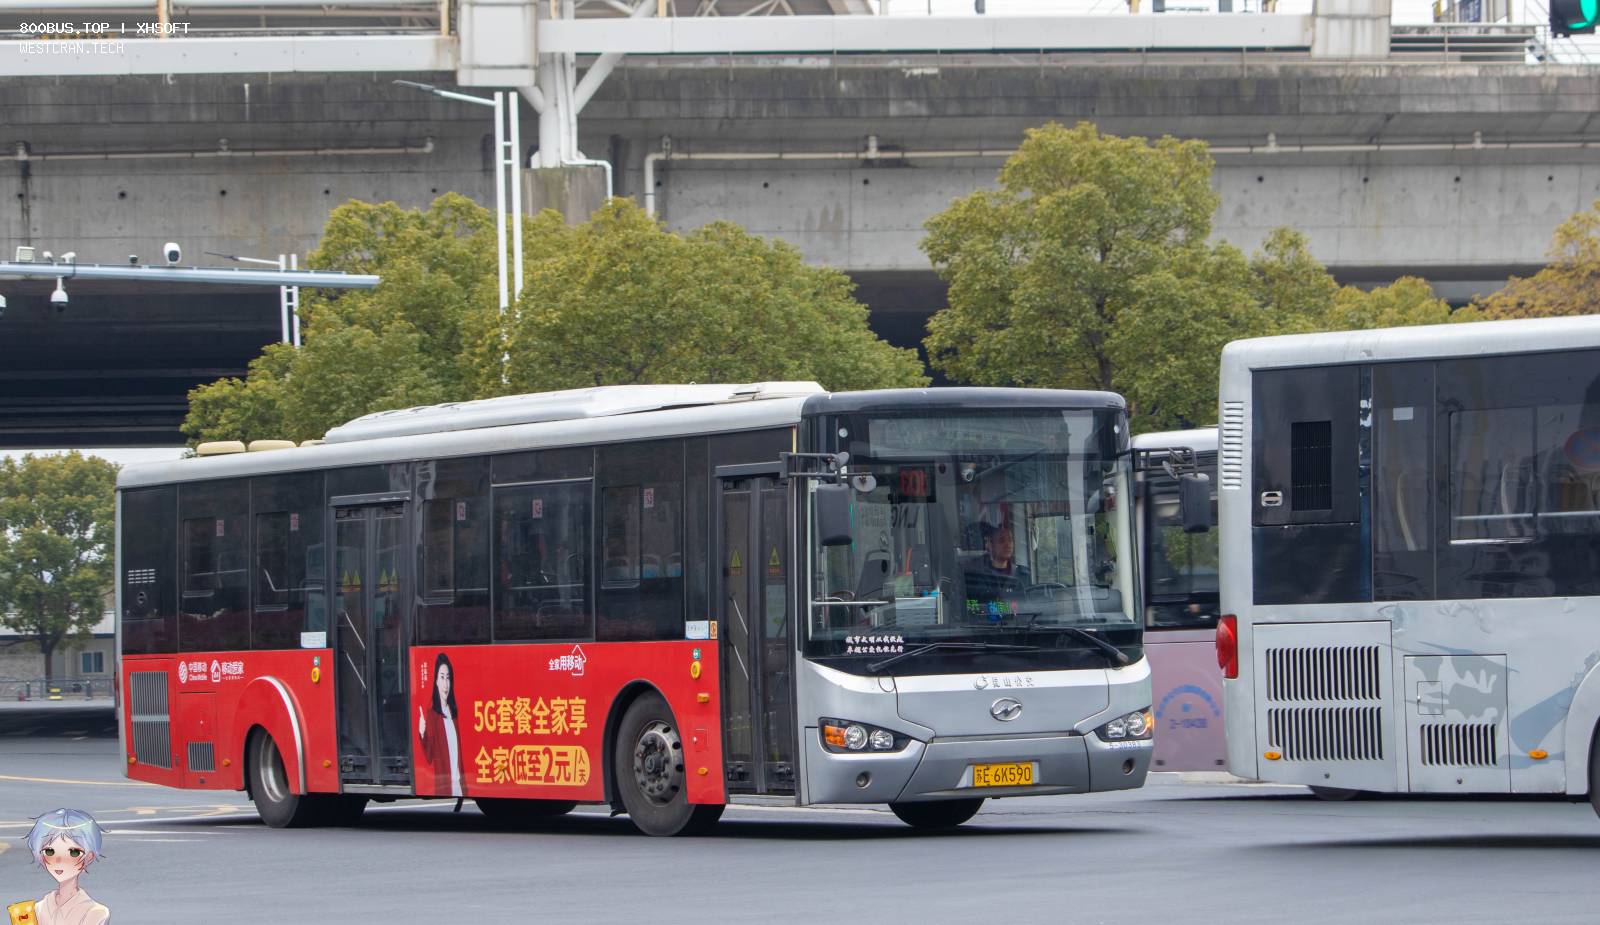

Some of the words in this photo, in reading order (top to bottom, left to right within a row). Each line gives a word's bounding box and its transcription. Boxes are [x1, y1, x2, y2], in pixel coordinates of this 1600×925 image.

[473, 696, 588, 735] 5G套餐全家享
